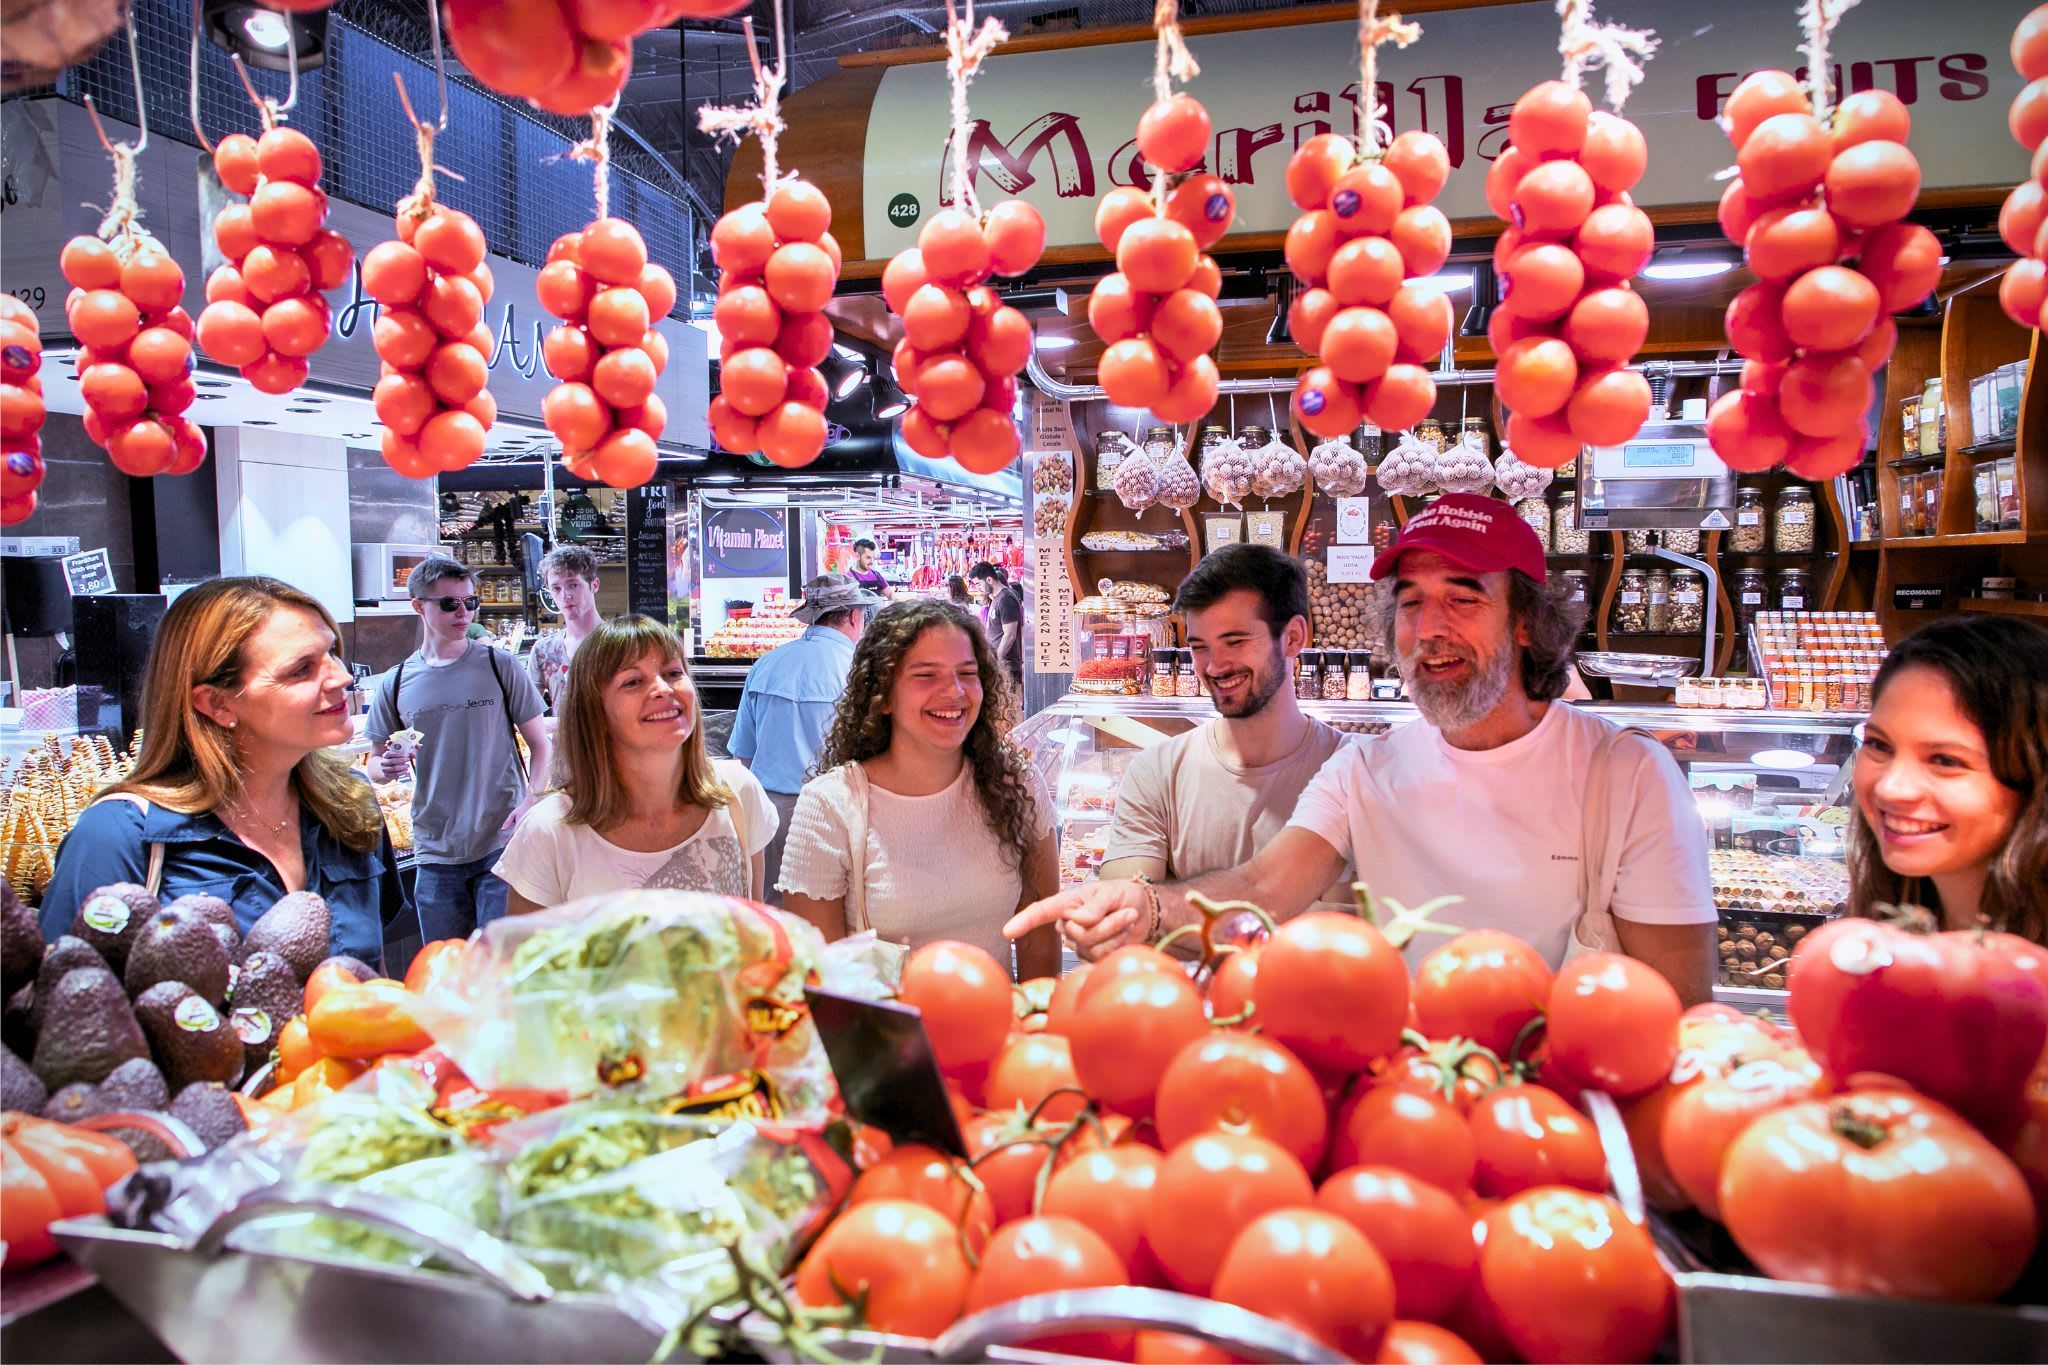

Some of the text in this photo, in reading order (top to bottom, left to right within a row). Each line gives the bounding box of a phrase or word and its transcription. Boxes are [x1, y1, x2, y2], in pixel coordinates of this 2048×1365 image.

[1696, 54, 1989, 120] FUITS
[890, 204, 918, 217] 428
[10, 286, 46, 310] 29
[1437, 504, 1494, 523] Robbie
[1438, 516, 1487, 534] Again
[707, 525, 785, 558] Vitamin Planet
[71, 555, 100, 566] Frankfurt
[86, 562, 104, 571] vegan
[79, 579, 101, 593] 3,80
[1038, 548, 1051, 667] MEDITERRANEAN DIET
[465, 699, 495, 709] Jeans
